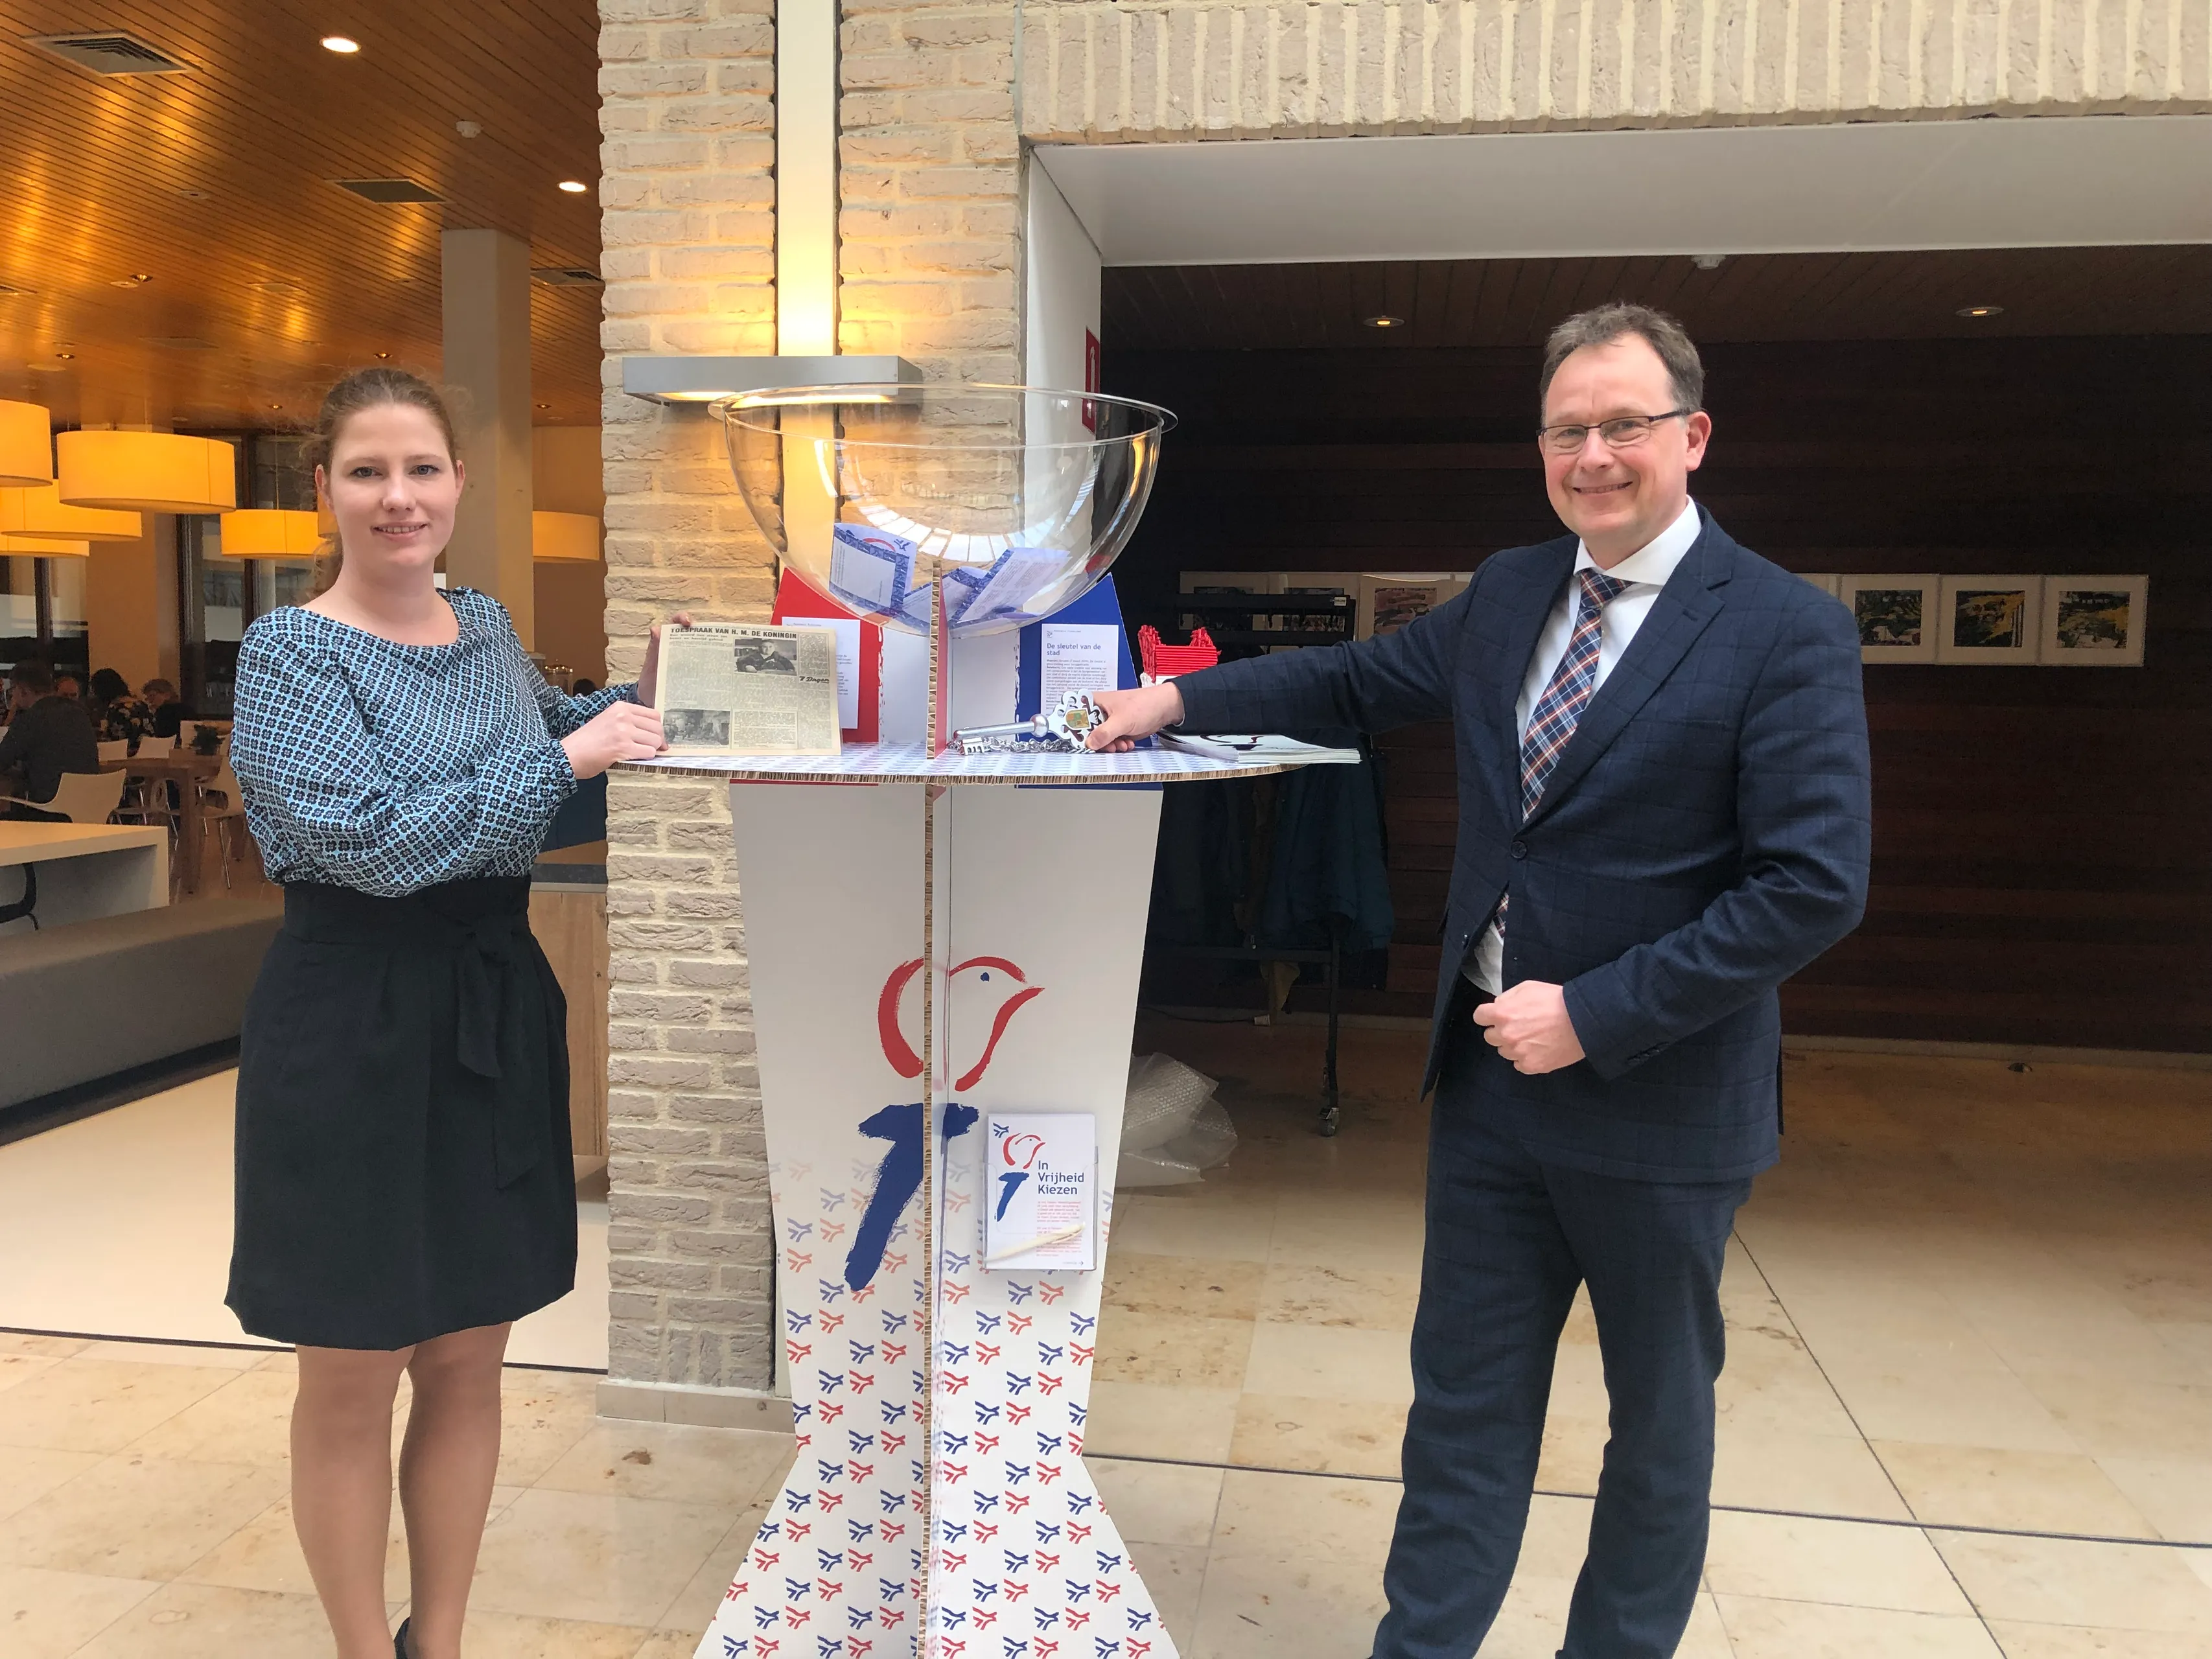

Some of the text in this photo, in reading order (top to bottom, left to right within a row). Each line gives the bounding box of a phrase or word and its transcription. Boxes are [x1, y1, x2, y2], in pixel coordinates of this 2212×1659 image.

[1038, 1160, 1049, 1170] In
[1038, 1172, 1084, 1185] Vrijheid
[1038, 1184, 1078, 1194] Kiezen
